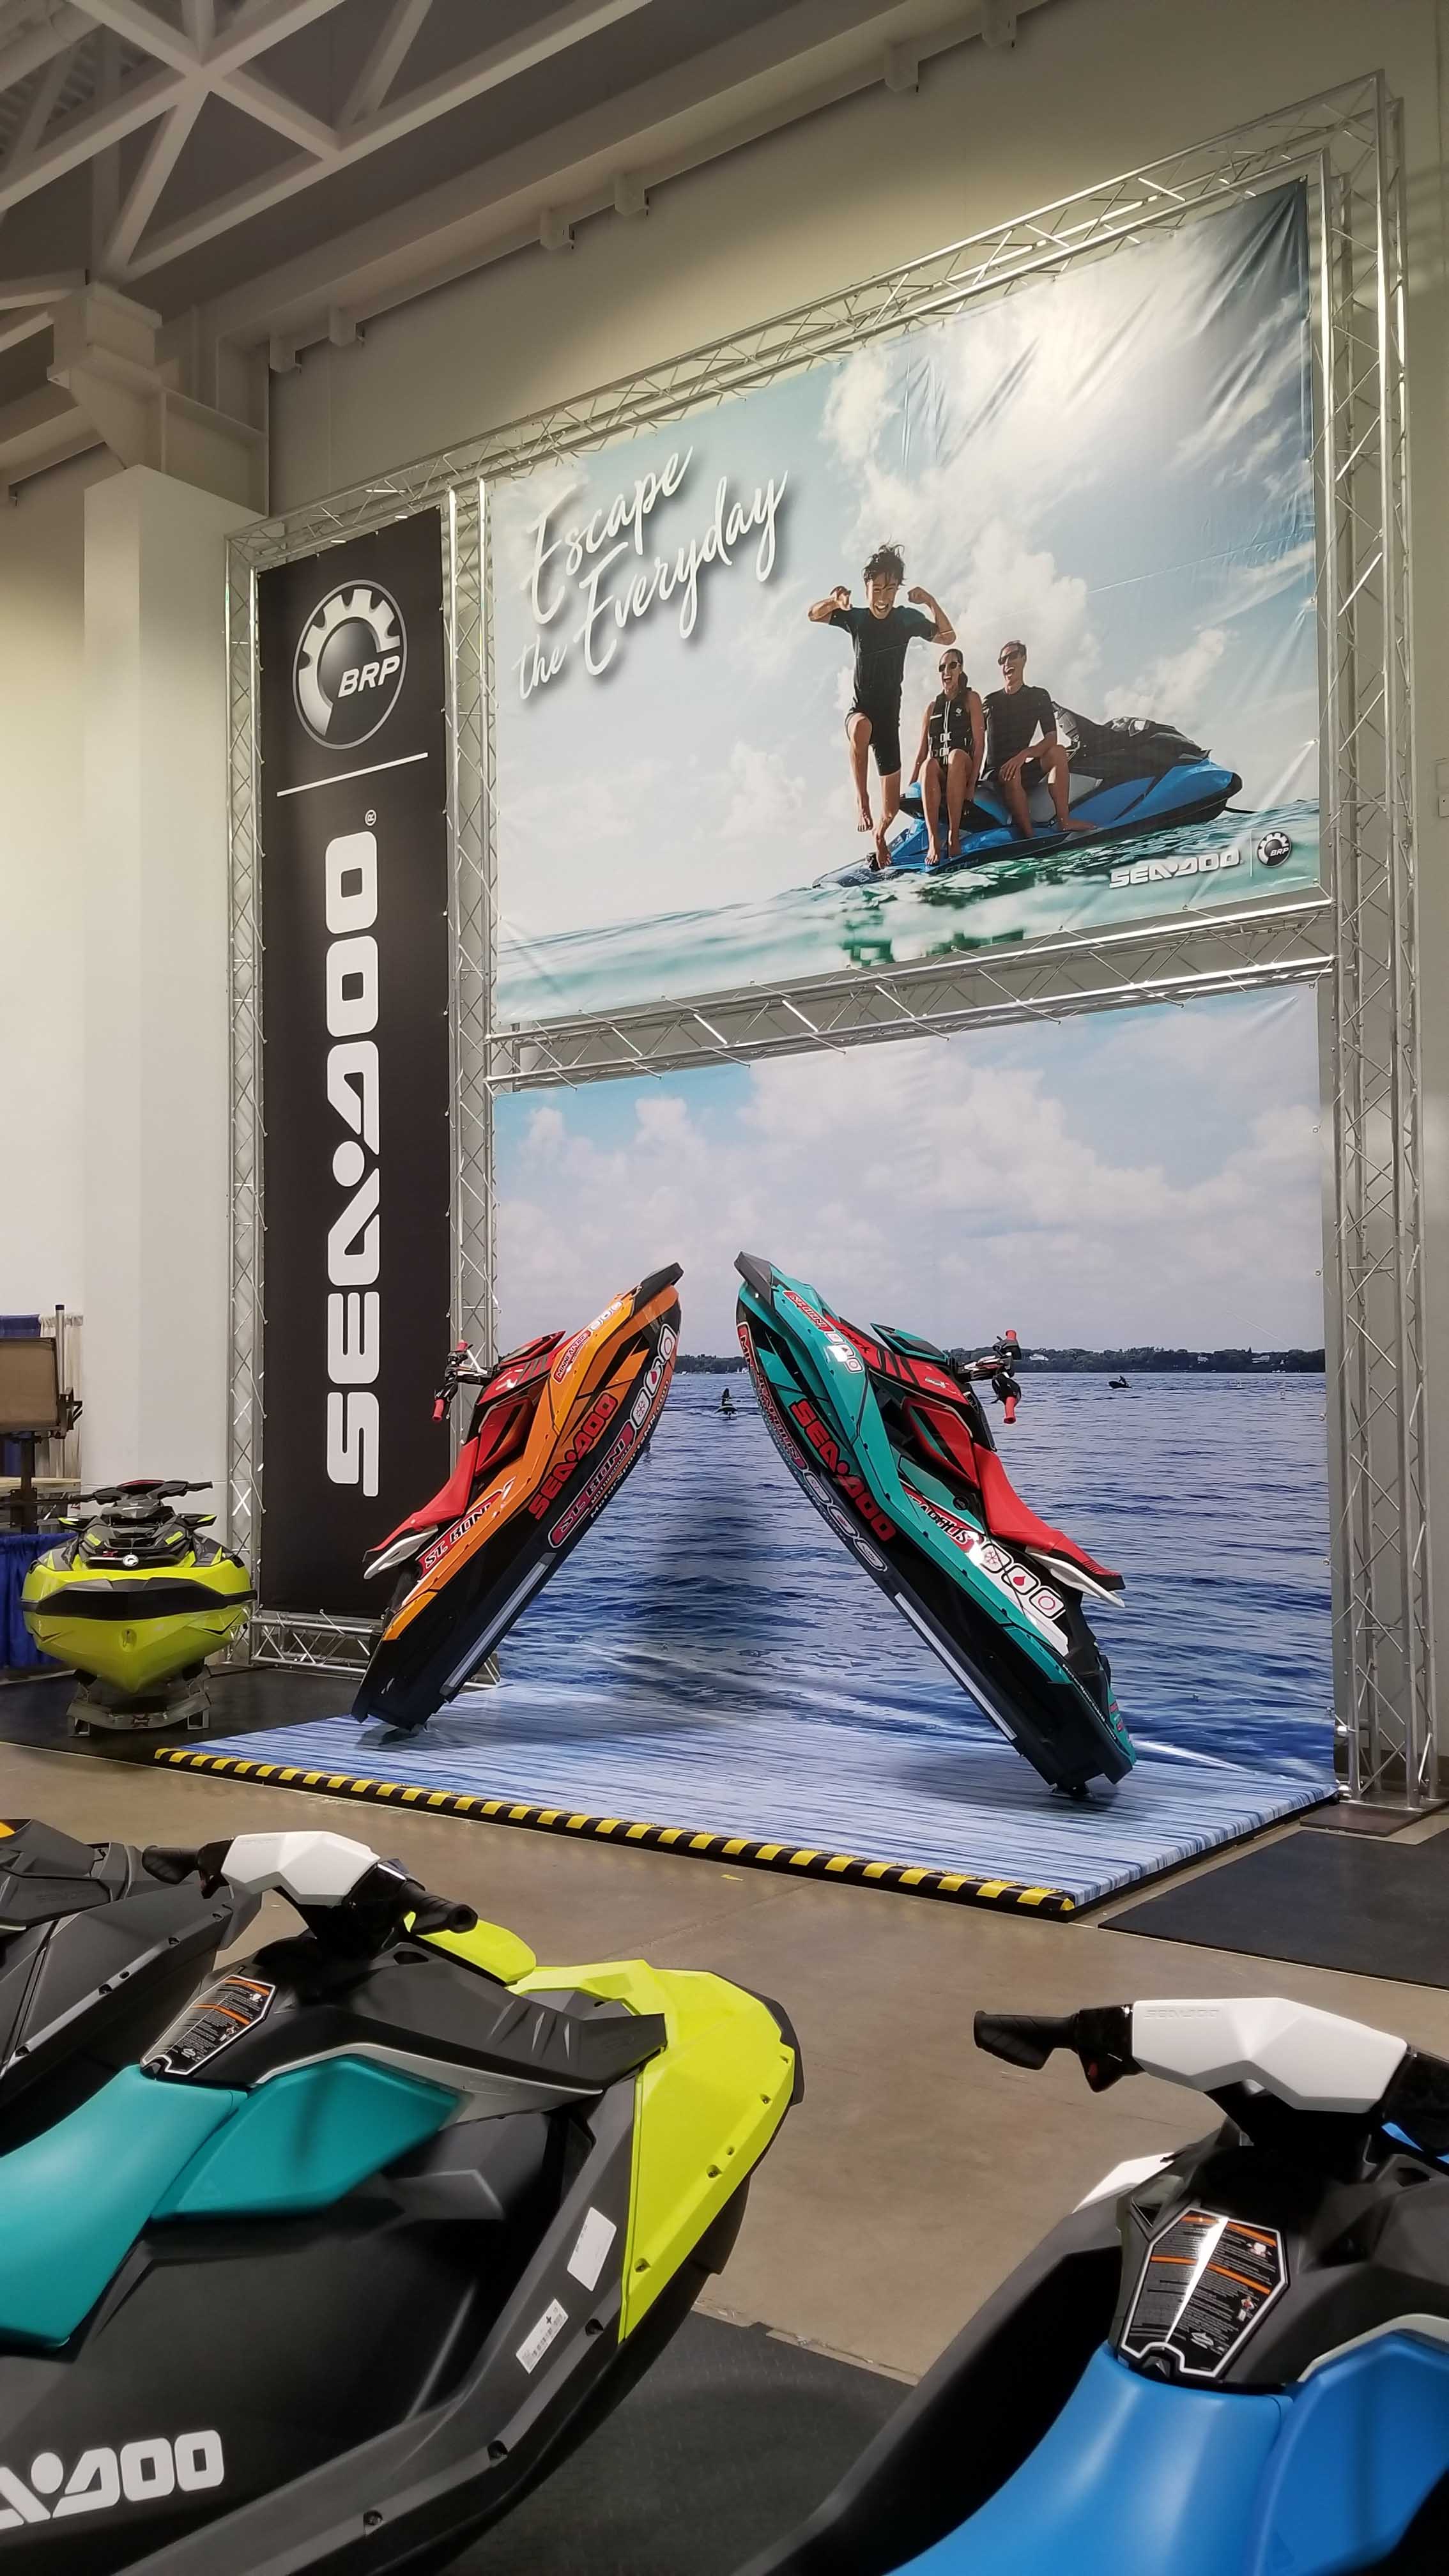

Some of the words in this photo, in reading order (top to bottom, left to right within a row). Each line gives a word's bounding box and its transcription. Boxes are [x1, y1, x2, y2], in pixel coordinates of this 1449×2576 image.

[514, 634, 568, 700] the
[572, 470, 789, 676] Everyday
[521, 446, 694, 625] Escape
[338, 655, 401, 698] BRP
[1270, 847, 1290, 857] BRP
